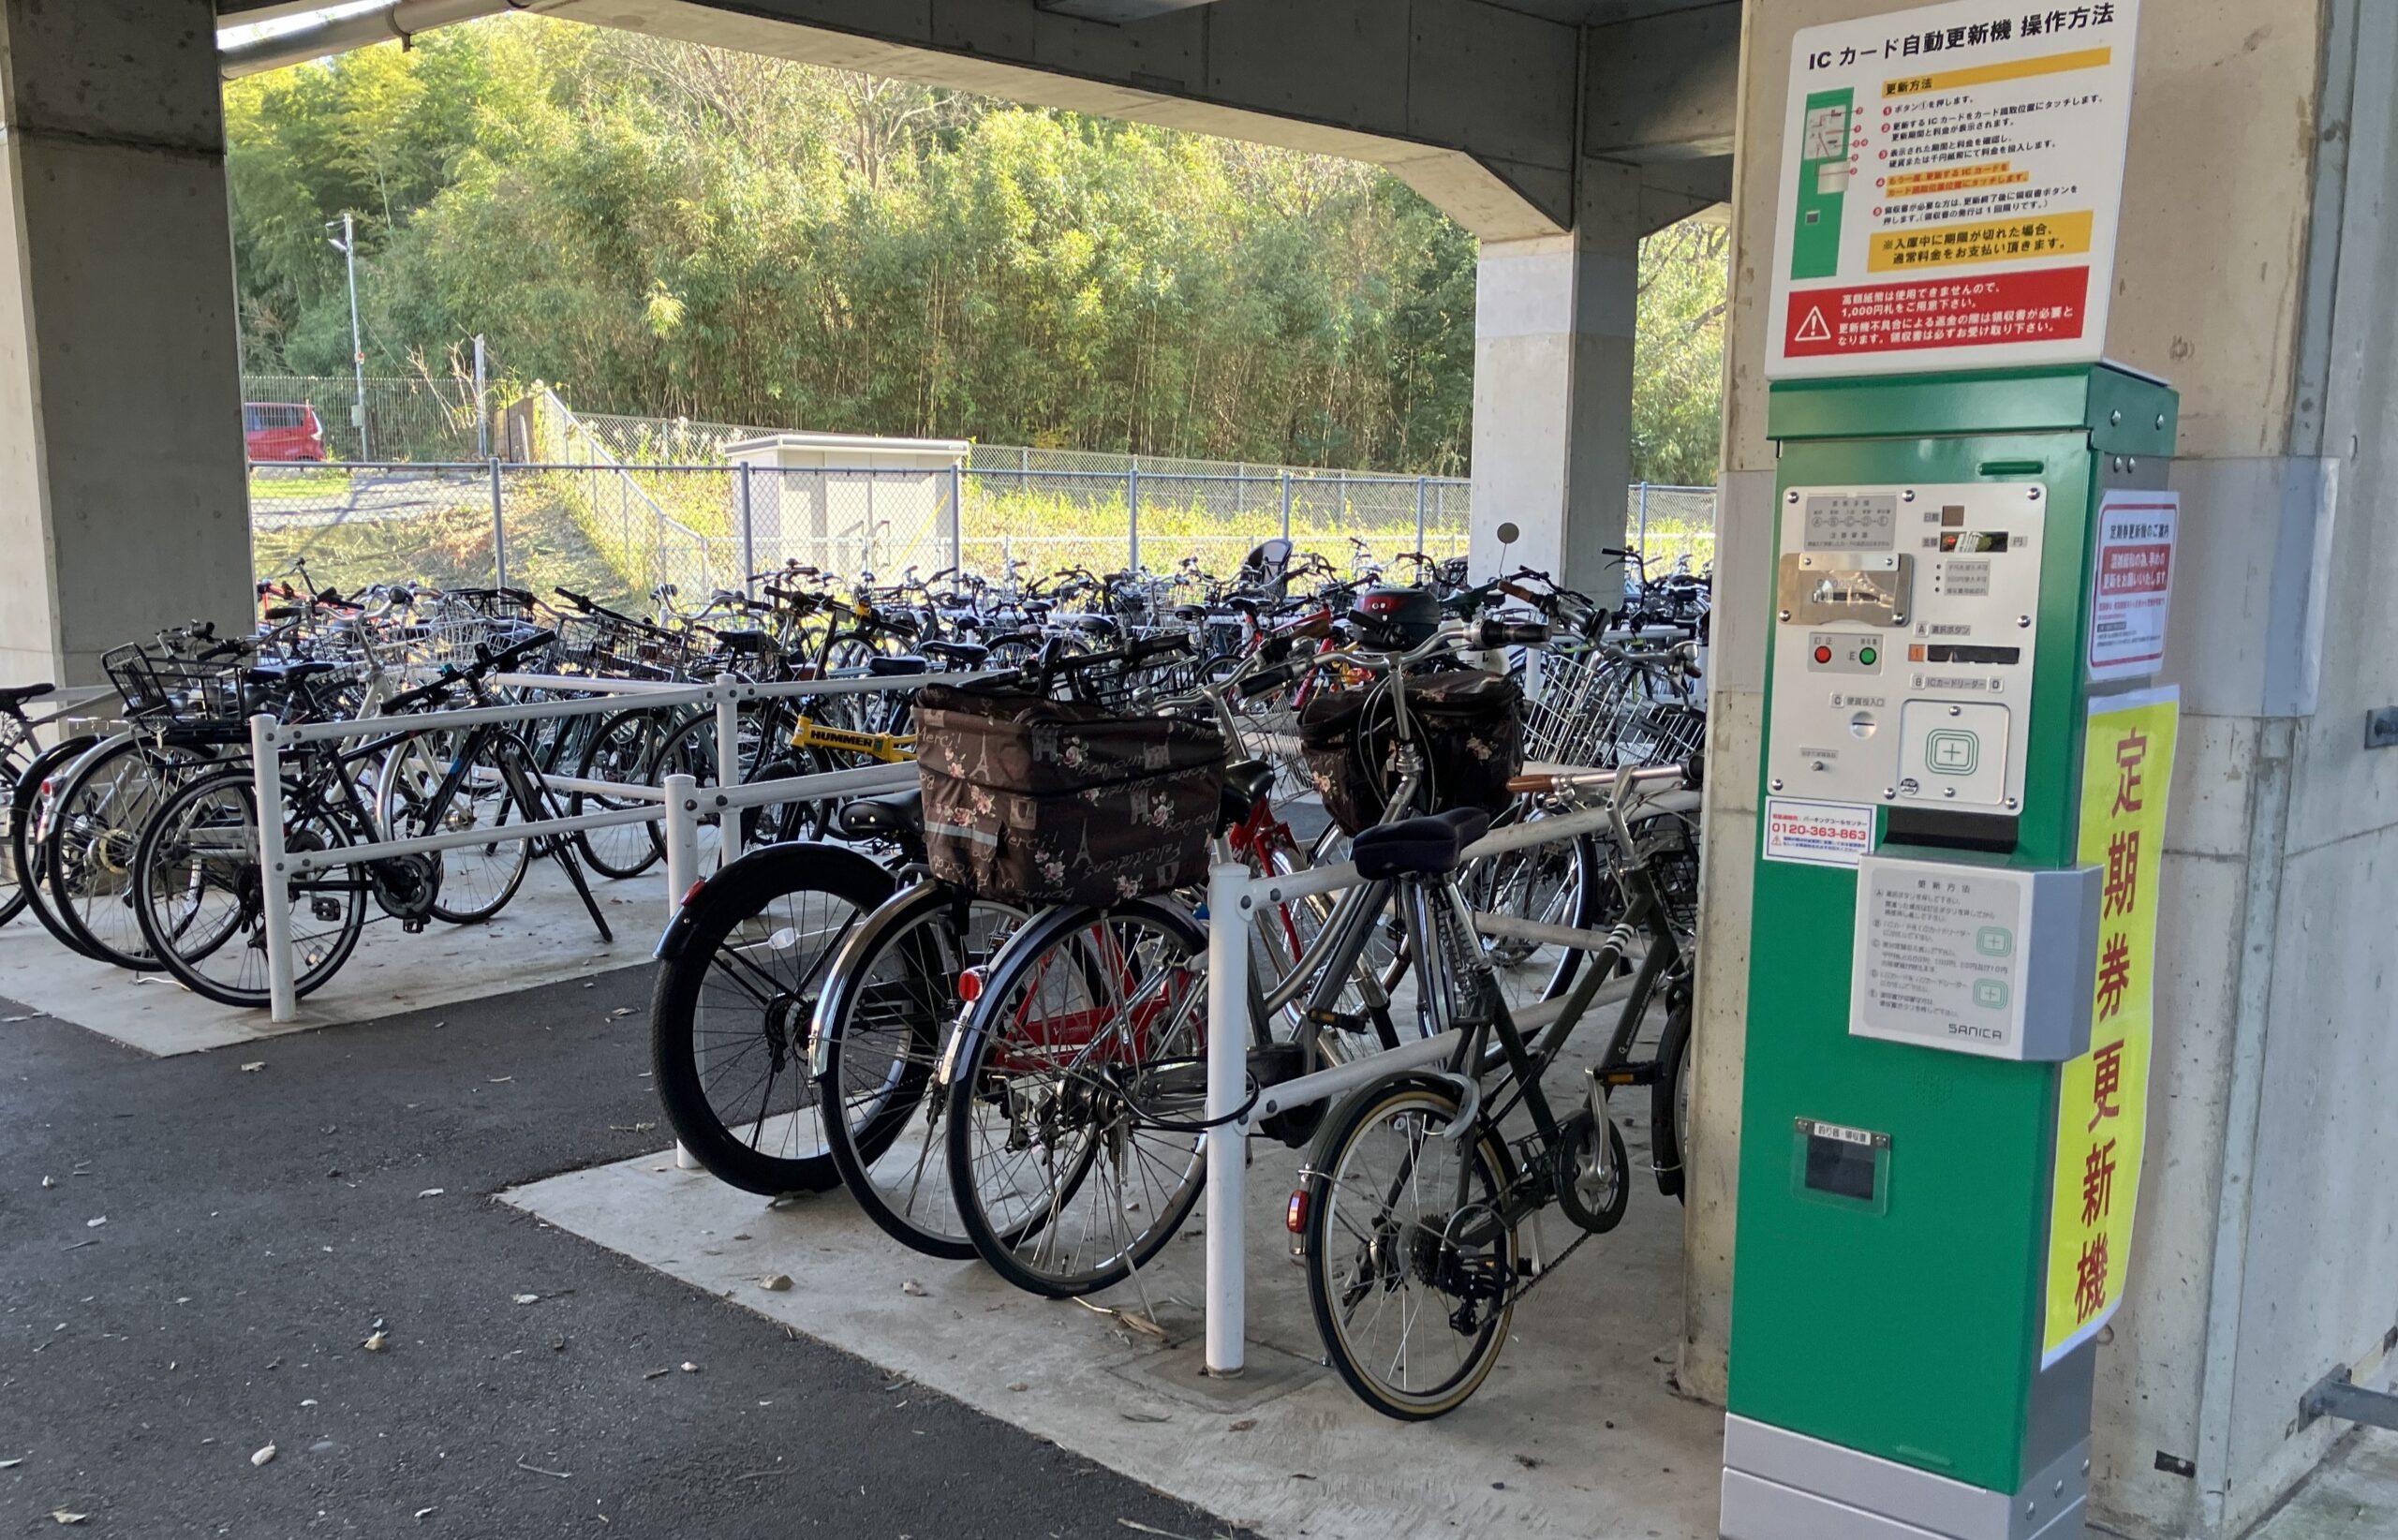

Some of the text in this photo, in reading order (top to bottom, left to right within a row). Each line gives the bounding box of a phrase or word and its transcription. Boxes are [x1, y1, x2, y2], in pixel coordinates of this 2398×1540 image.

[1809, 3, 2114, 70] IC カード自動更新機 操作方法
[810, 730, 873, 748] HUMMER
[1771, 822, 1867, 840] 0120-363-863
[1948, 1023, 2002, 1040] SANICA
[2074, 726, 2147, 1325] 定期券更新機
